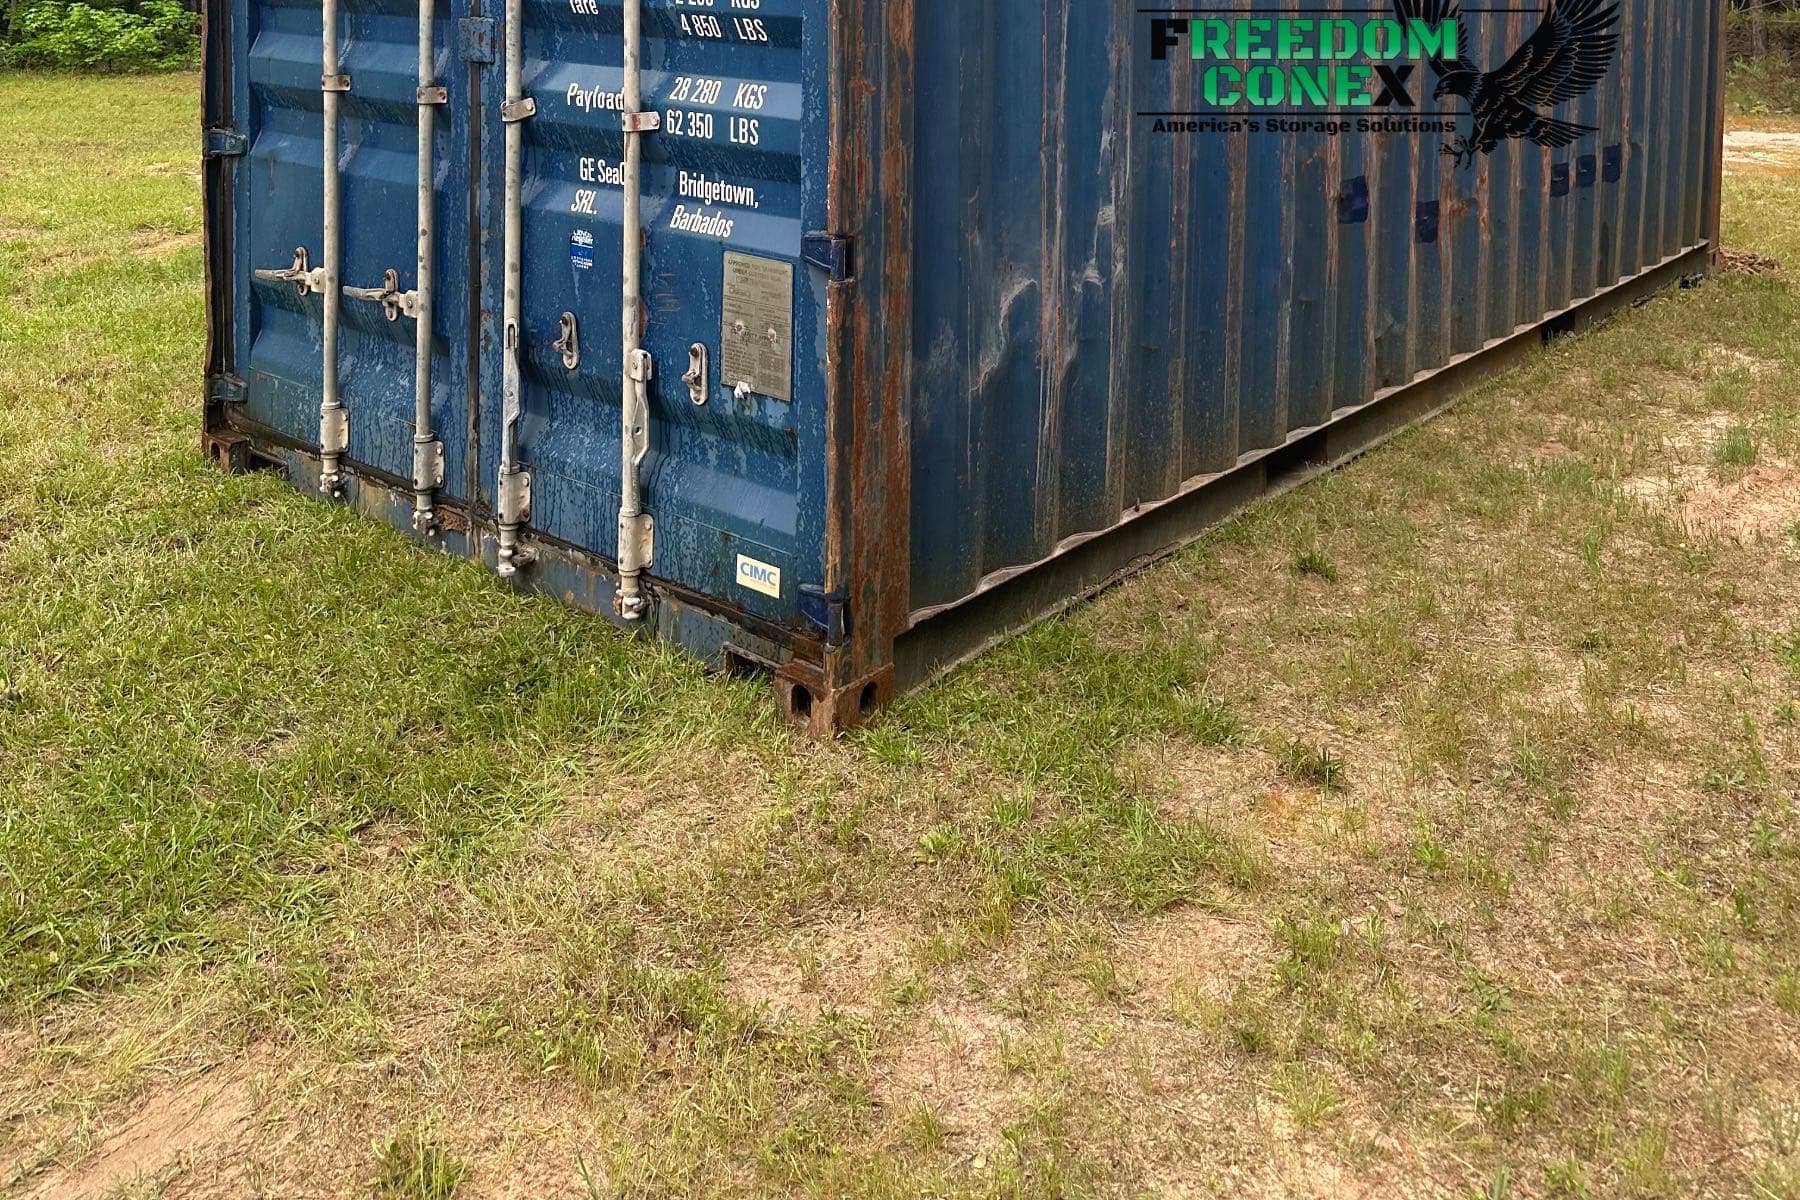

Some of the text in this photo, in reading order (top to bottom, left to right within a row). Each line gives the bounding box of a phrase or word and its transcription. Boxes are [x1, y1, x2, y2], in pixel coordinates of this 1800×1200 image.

[734, 17, 768, 42] LBS
[566, 83, 624, 113] Payload
[733, 82, 767, 110] KGS
[730, 117, 759, 145] LBS
[580, 157, 625, 186] GE Sea
[571, 189, 597, 215] SRL.
[679, 170, 759, 209] Bridgetown,
[670, 205, 733, 238] Barbados
[740, 562, 776, 587] CIMC
